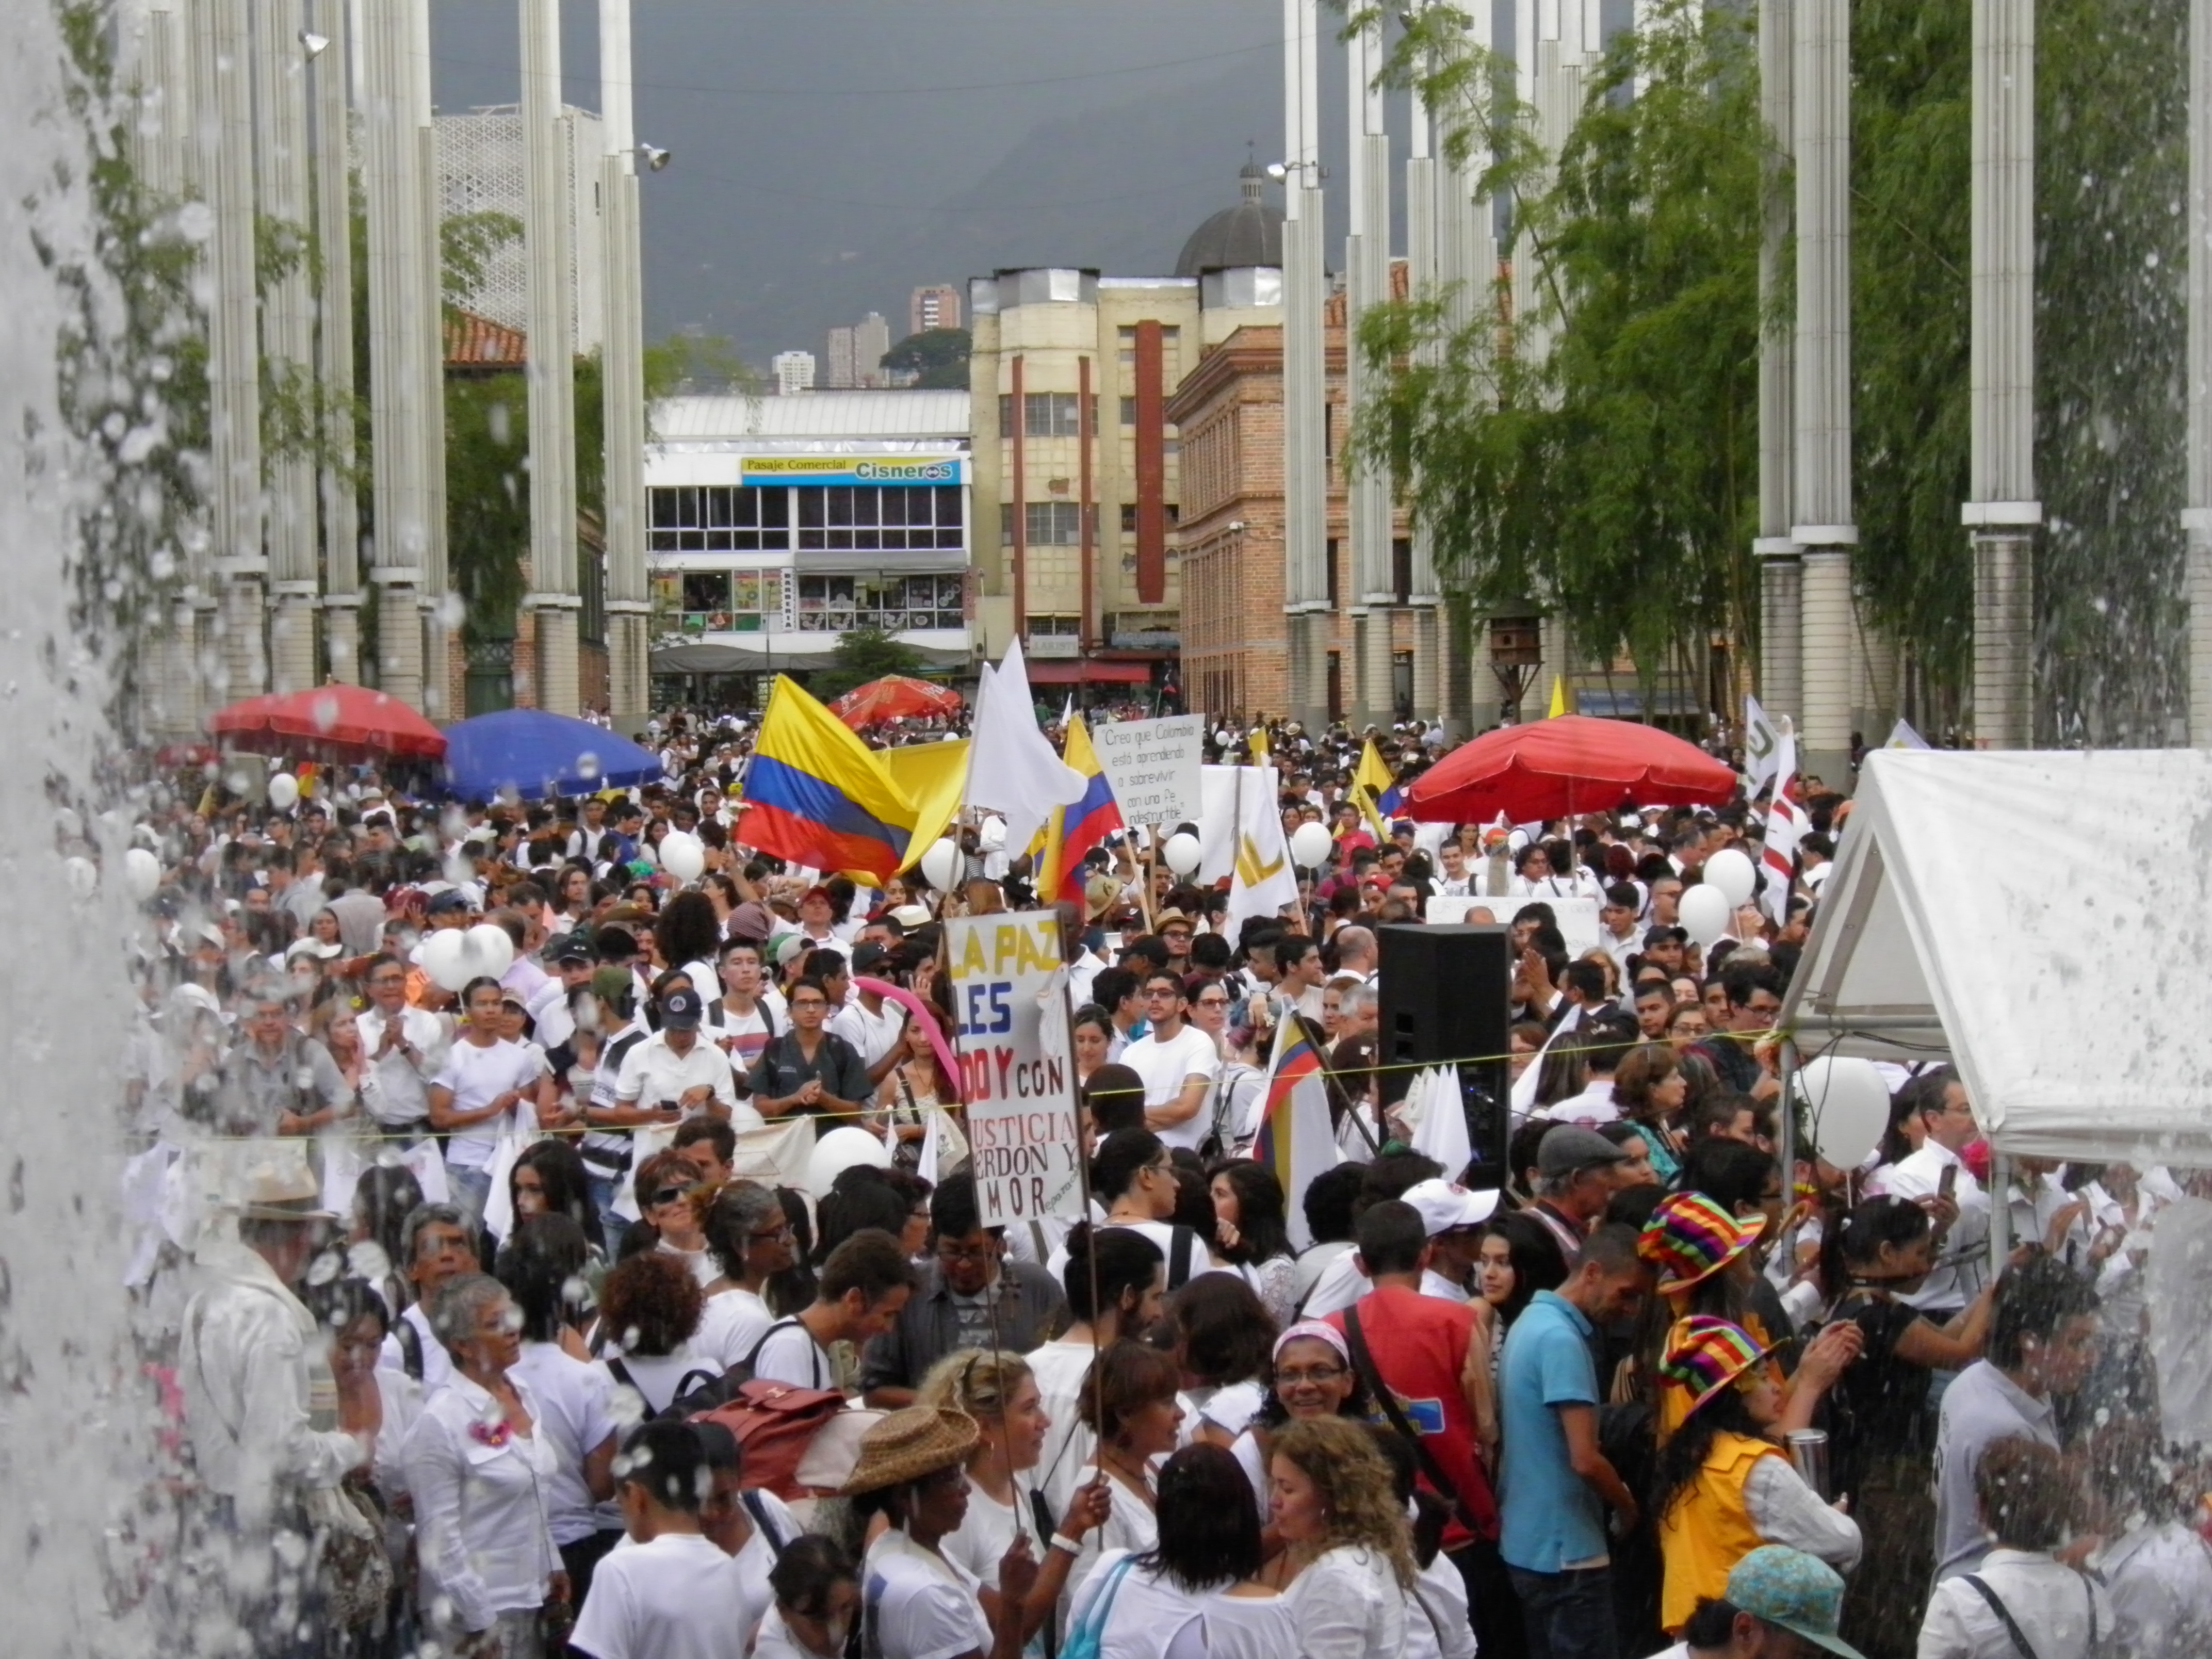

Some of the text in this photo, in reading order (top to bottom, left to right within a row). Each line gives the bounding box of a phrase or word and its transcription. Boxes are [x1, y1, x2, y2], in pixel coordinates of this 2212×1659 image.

[747, 460, 846, 471] Pasaje Comercial
[1135, 730, 1151, 749] que
[1156, 721, 1194, 739] Colombia
[1118, 770, 1175, 787] a sobrevivir
[1127, 798, 1142, 808] con
[1145, 794, 1160, 806] una
[994, 920, 1061, 976] PAZ
[1016, 1056, 1064, 1098] CON
[973, 1111, 1077, 1148] USTICIA
[974, 1142, 1079, 1180] ERDON Y
